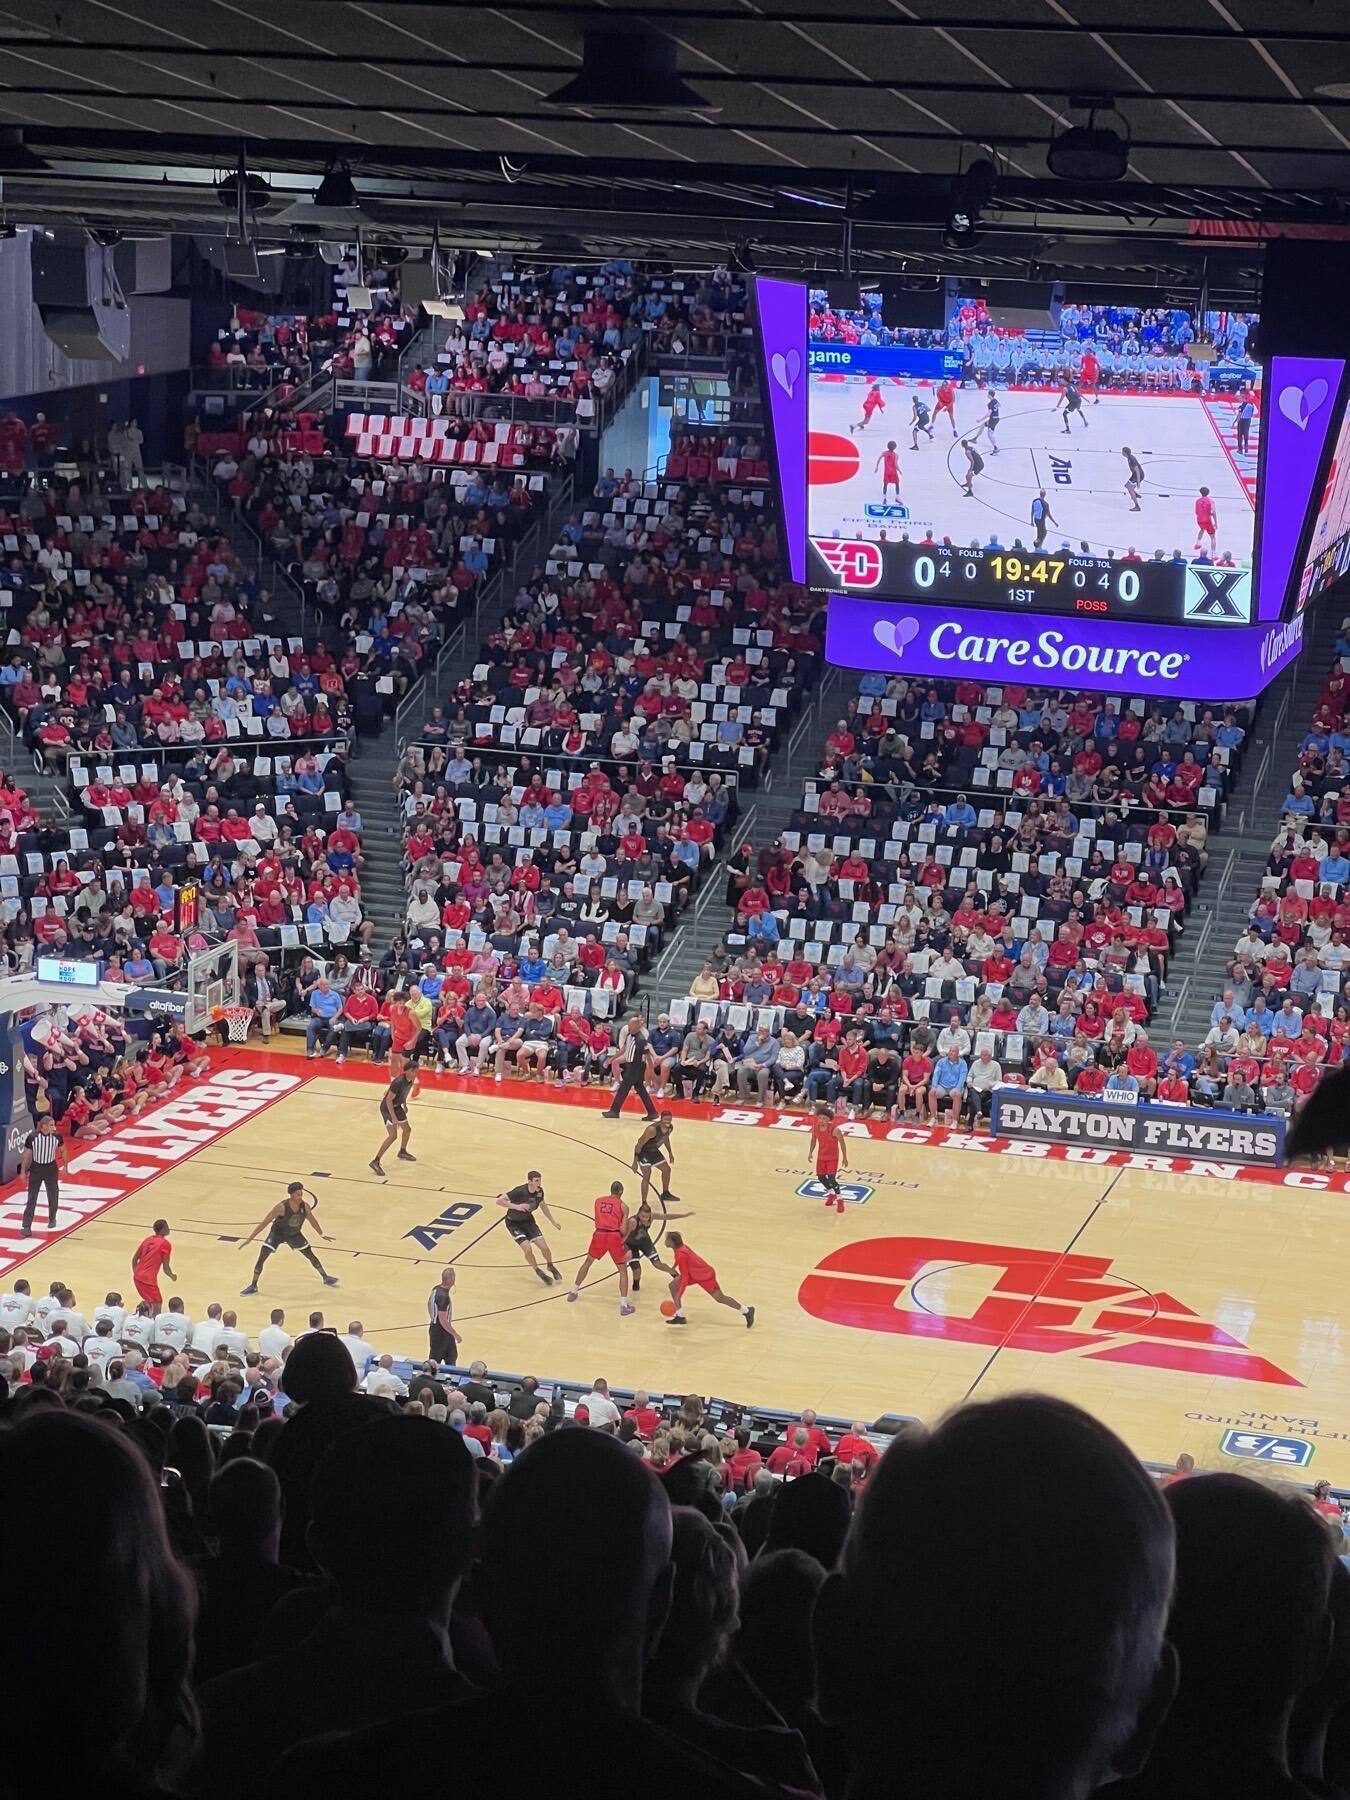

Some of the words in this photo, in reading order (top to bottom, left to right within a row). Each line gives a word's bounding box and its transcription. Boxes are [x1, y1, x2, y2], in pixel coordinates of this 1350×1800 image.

[809, 351, 851, 365] game
[938, 548, 952, 557] TOL
[958, 549, 984, 559] FOULS
[1068, 558, 1094, 568] FOULS
[1097, 560, 1112, 569] TOL
[914, 556, 936, 588] 0
[939, 561, 951, 578] 4
[965, 563, 977, 580] 0
[990, 556, 1065, 584] 19:47
[1074, 571, 1086, 588] 0
[1097, 573, 1110, 590] 4
[1118, 570, 1140, 602] 0
[1008, 588, 1036, 602] 1ST
[1076, 599, 1108, 612] POSS
[149, 1000, 185, 1014] altafiber
[1106, 1090, 1135, 1101] WHIO
[61, 1068, 302, 1180] FLYERS
[1000, 1103, 1136, 1142] DAYTON
[1144, 1120, 1277, 1157] FLYERS
[1284, 1172, 1350, 1193] C
[1184, 1412, 1274, 1432] THIRD
[1240, 1410, 1320, 1428] BANK
